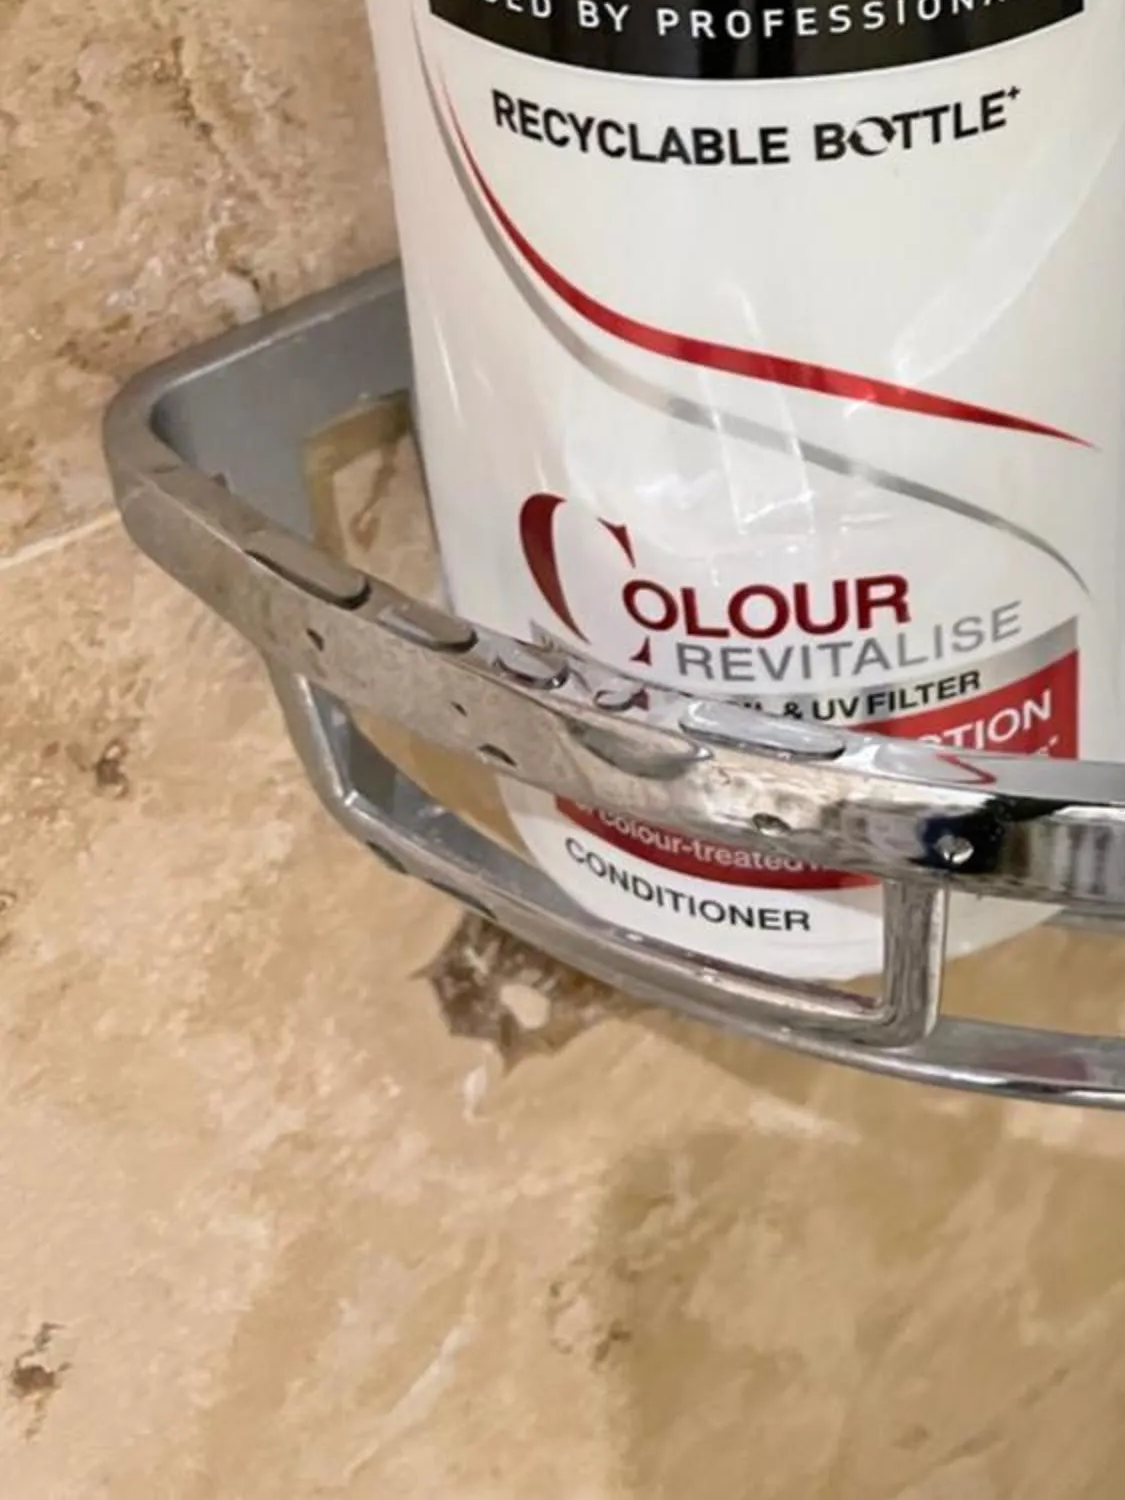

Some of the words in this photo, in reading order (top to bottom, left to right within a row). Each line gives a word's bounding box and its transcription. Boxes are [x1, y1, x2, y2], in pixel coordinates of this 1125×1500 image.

[577, 0, 630, 33] BY
[491, 88, 790, 166] RECYCLABLE
[519, 492, 913, 666] COLOUR
[675, 600, 1023, 683] REVITALISE
[812, 695, 859, 721] UV
[867, 669, 982, 716] FILTER
[564, 836, 812, 932] CONDITIONER
